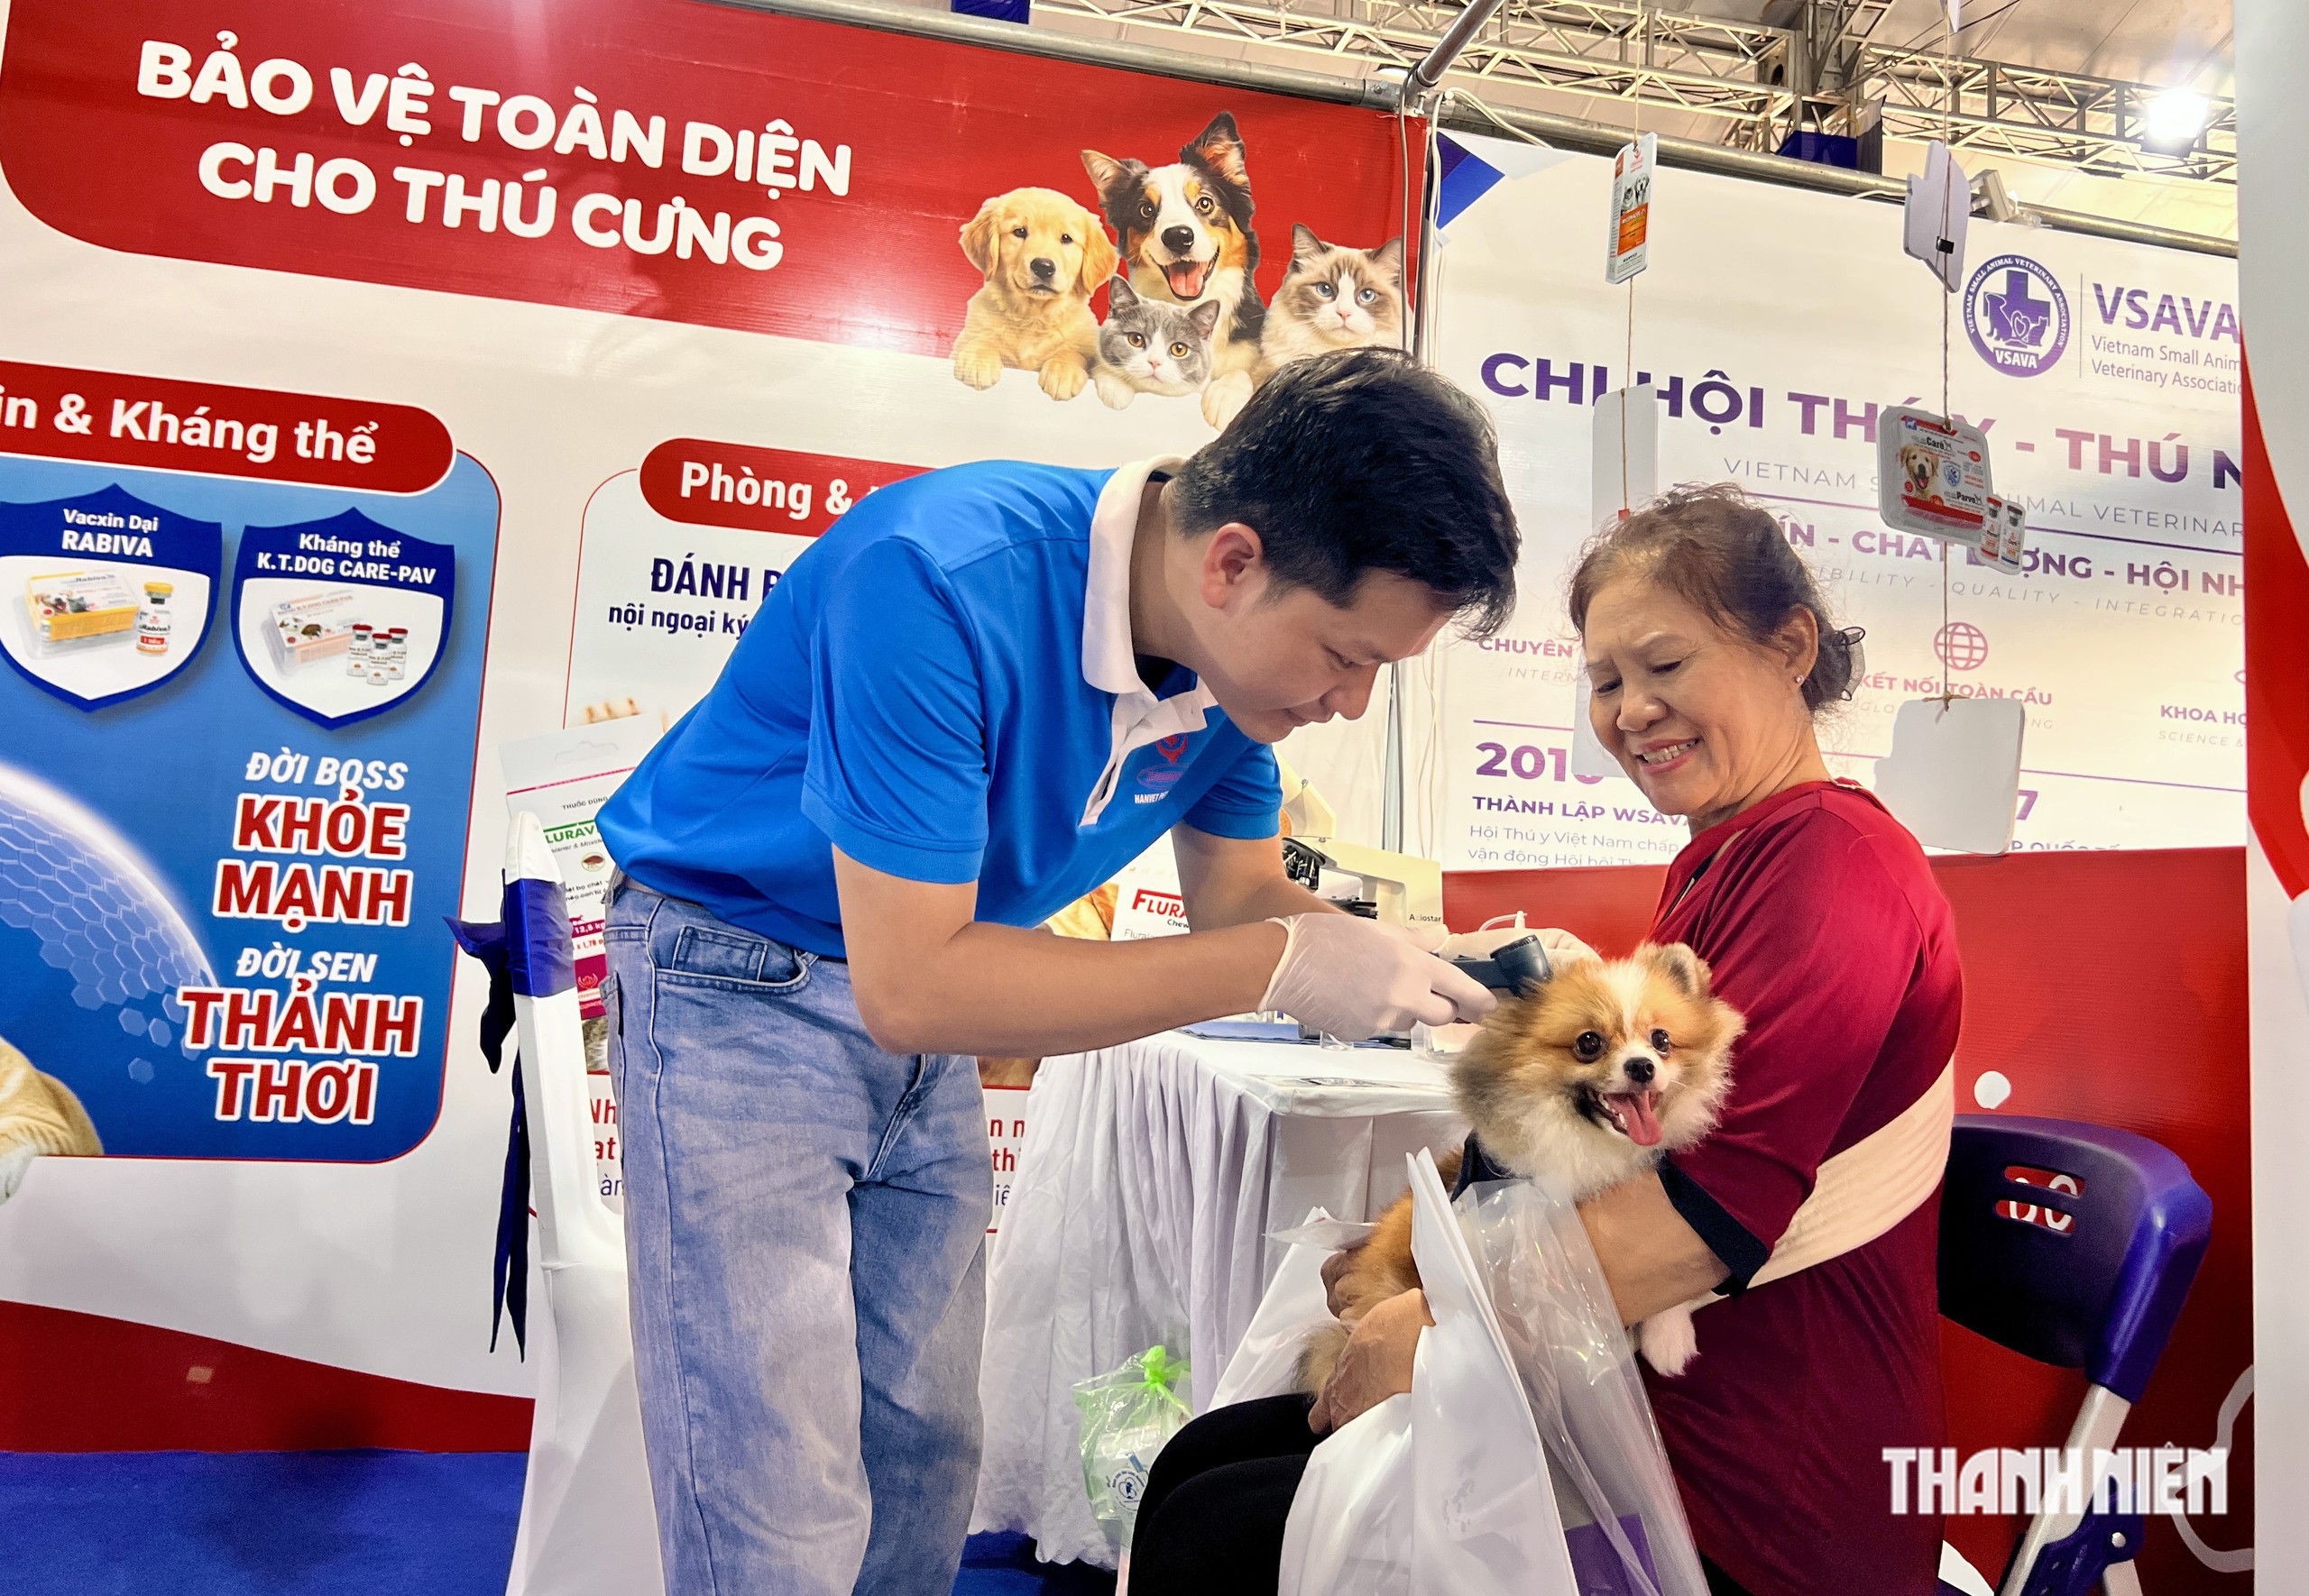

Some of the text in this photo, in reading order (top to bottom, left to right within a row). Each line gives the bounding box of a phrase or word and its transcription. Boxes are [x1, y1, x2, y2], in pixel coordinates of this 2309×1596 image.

[137, 30, 852, 199] BẢO VỆ TOÀN DIỆN
[198, 141, 784, 271] CHO THÚ CƯNG
[1970, 270, 1987, 293] SMALL
[1986, 258, 2013, 272] ANIMAL
[2015, 258, 2056, 290] VETERINARY
[2093, 283, 2240, 344] VSAVA
[1994, 349, 2038, 369] VSAVA
[2092, 335, 2154, 360] Vietnam
[2159, 344, 2200, 367] Small
[2092, 359, 2168, 389] Veterinary
[54, 393, 93, 435] &
[110, 398, 278, 463] Kháng
[295, 417, 379, 464] thể
[1480, 353, 1608, 407] CHI
[1636, 369, 1763, 436] HỘI
[2055, 432, 2188, 483] THÚ
[1724, 456, 1855, 491] VIETNAM
[681, 461, 852, 521] Phòng &
[63, 509, 159, 534] Vacxin Dại
[61, 529, 153, 558] RABIVA
[299, 533, 401, 558] Kháng thể
[257, 552, 437, 584] K.T.DOG CARE-PAV
[650, 553, 750, 601] ĐÁNH
[2127, 561, 2188, 595] HỘI
[1951, 580, 2060, 605] QUALITY
[608, 602, 750, 640] nội ngoại ký
[1477, 637, 1572, 658] CHUYÊN
[1903, 676, 1940, 694] NỐI
[2160, 704, 2217, 723] KHOA
[2157, 729, 2228, 747] SCIENCE
[245, 747, 409, 790] ĐỜI BOSS
[1475, 742, 1604, 784] 201
[235, 788, 408, 859] KHỎE
[1472, 794, 1553, 816] THÀNH
[1561, 801, 1605, 821] LẬP
[544, 821, 599, 844] LURAV
[1469, 825, 1498, 840] Hội
[1504, 827, 1535, 842] Thú
[1540, 830, 1550, 845] y
[1554, 830, 1587, 848] Việt
[1593, 835, 1633, 849] Nam
[1467, 848, 1499, 863] vận
[1504, 849, 1549, 867] động
[216, 862, 410, 930] MẠNH
[1409, 913, 1441, 922] Aiostar
[236, 941, 377, 983] ĐỜI SEN
[180, 978, 419, 1055] THẢNH
[210, 1060, 375, 1122] THƠI
